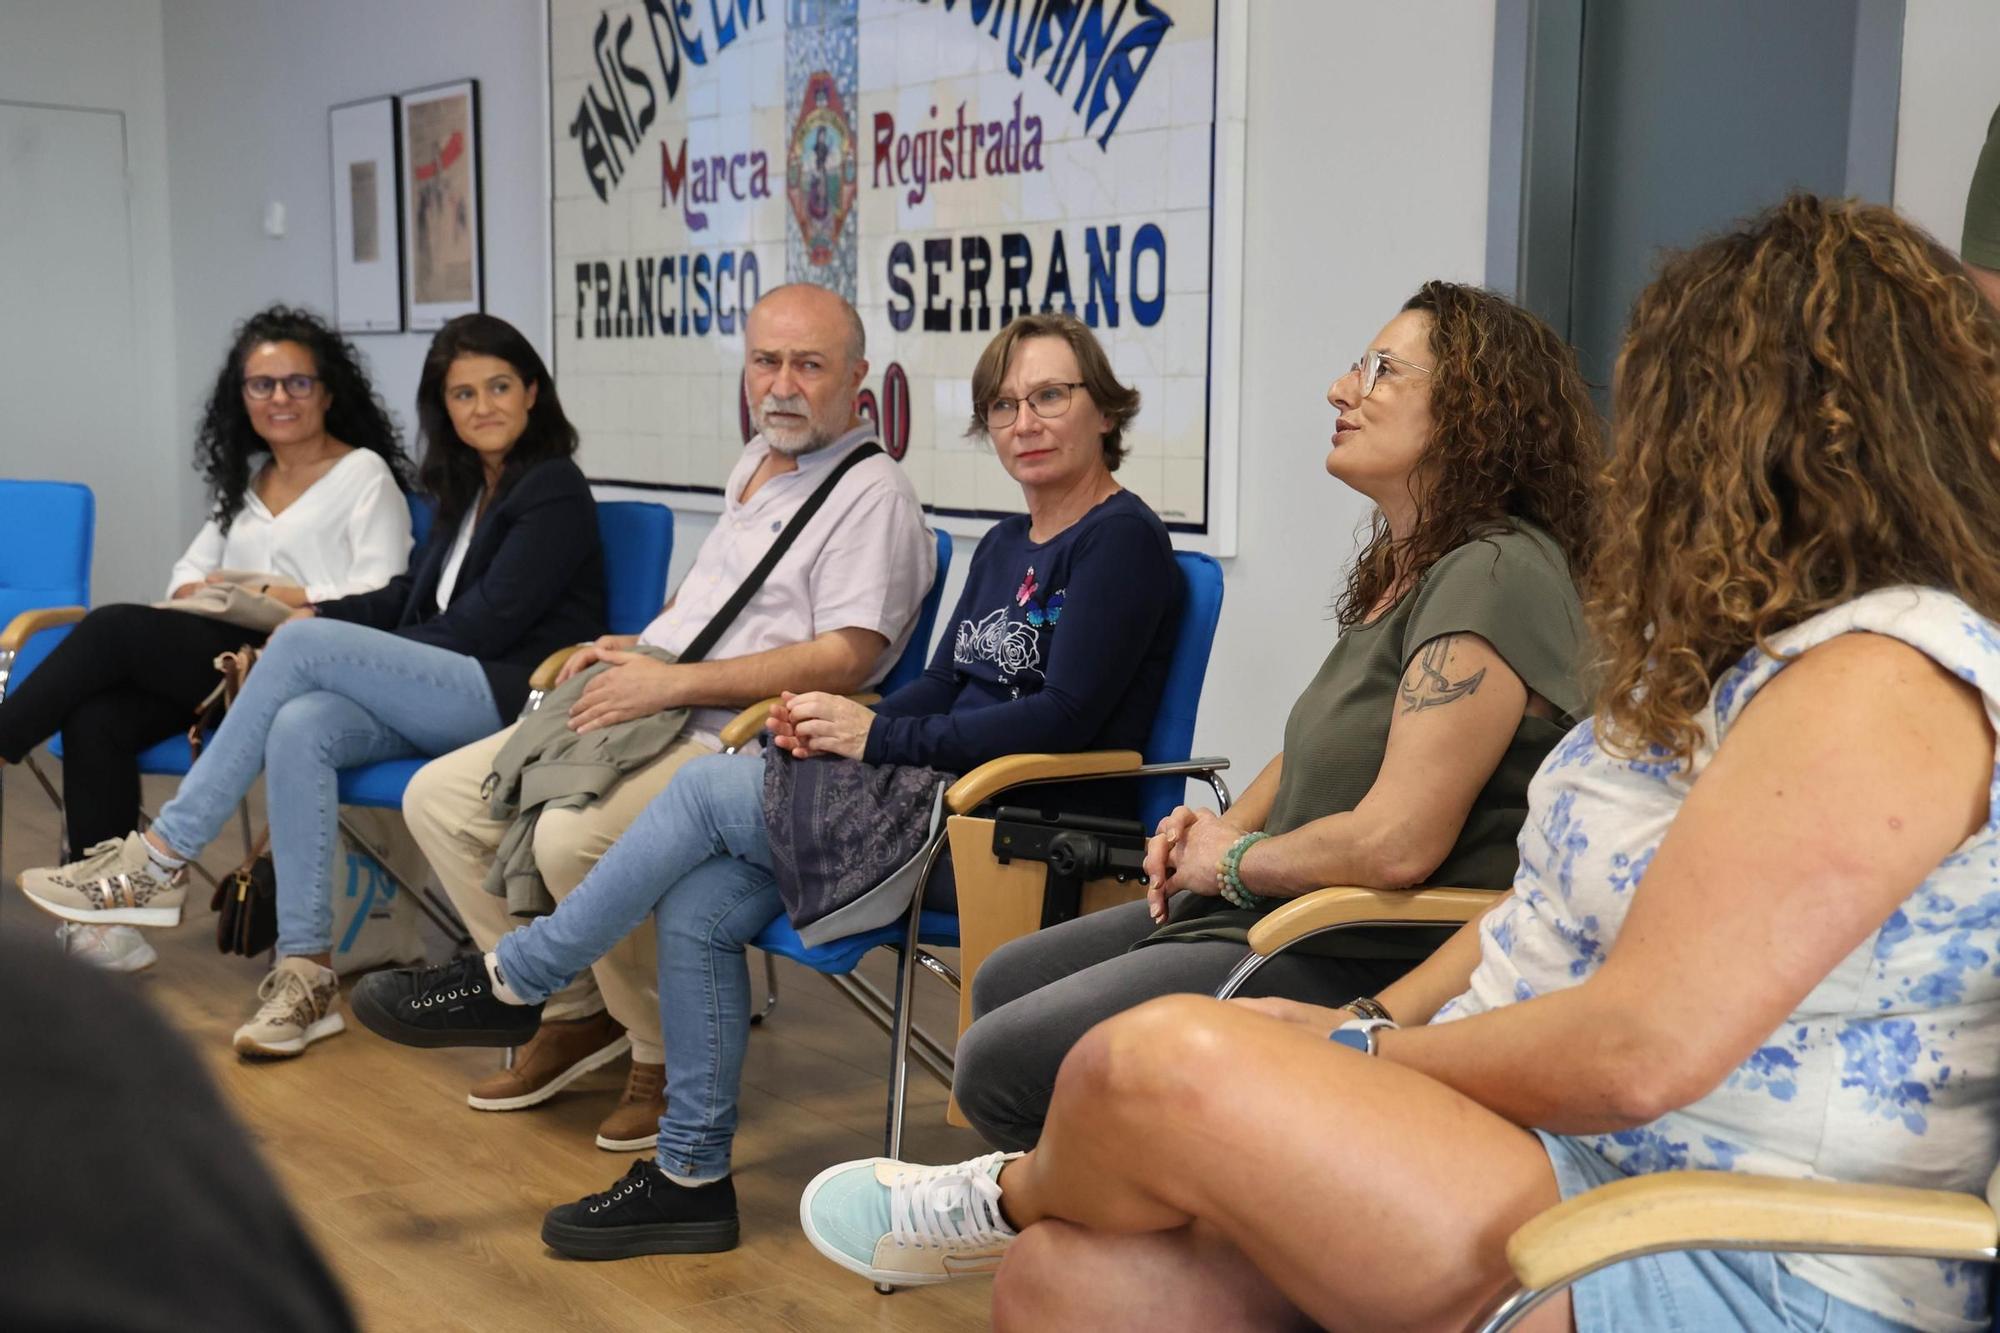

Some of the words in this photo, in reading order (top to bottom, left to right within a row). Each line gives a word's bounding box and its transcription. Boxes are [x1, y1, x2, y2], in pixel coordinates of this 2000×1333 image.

[659, 138, 771, 231] Marca
[872, 91, 1044, 208] Registrada
[576, 251, 759, 339] FRANCISCO
[887, 223, 1167, 332] SERRANO
